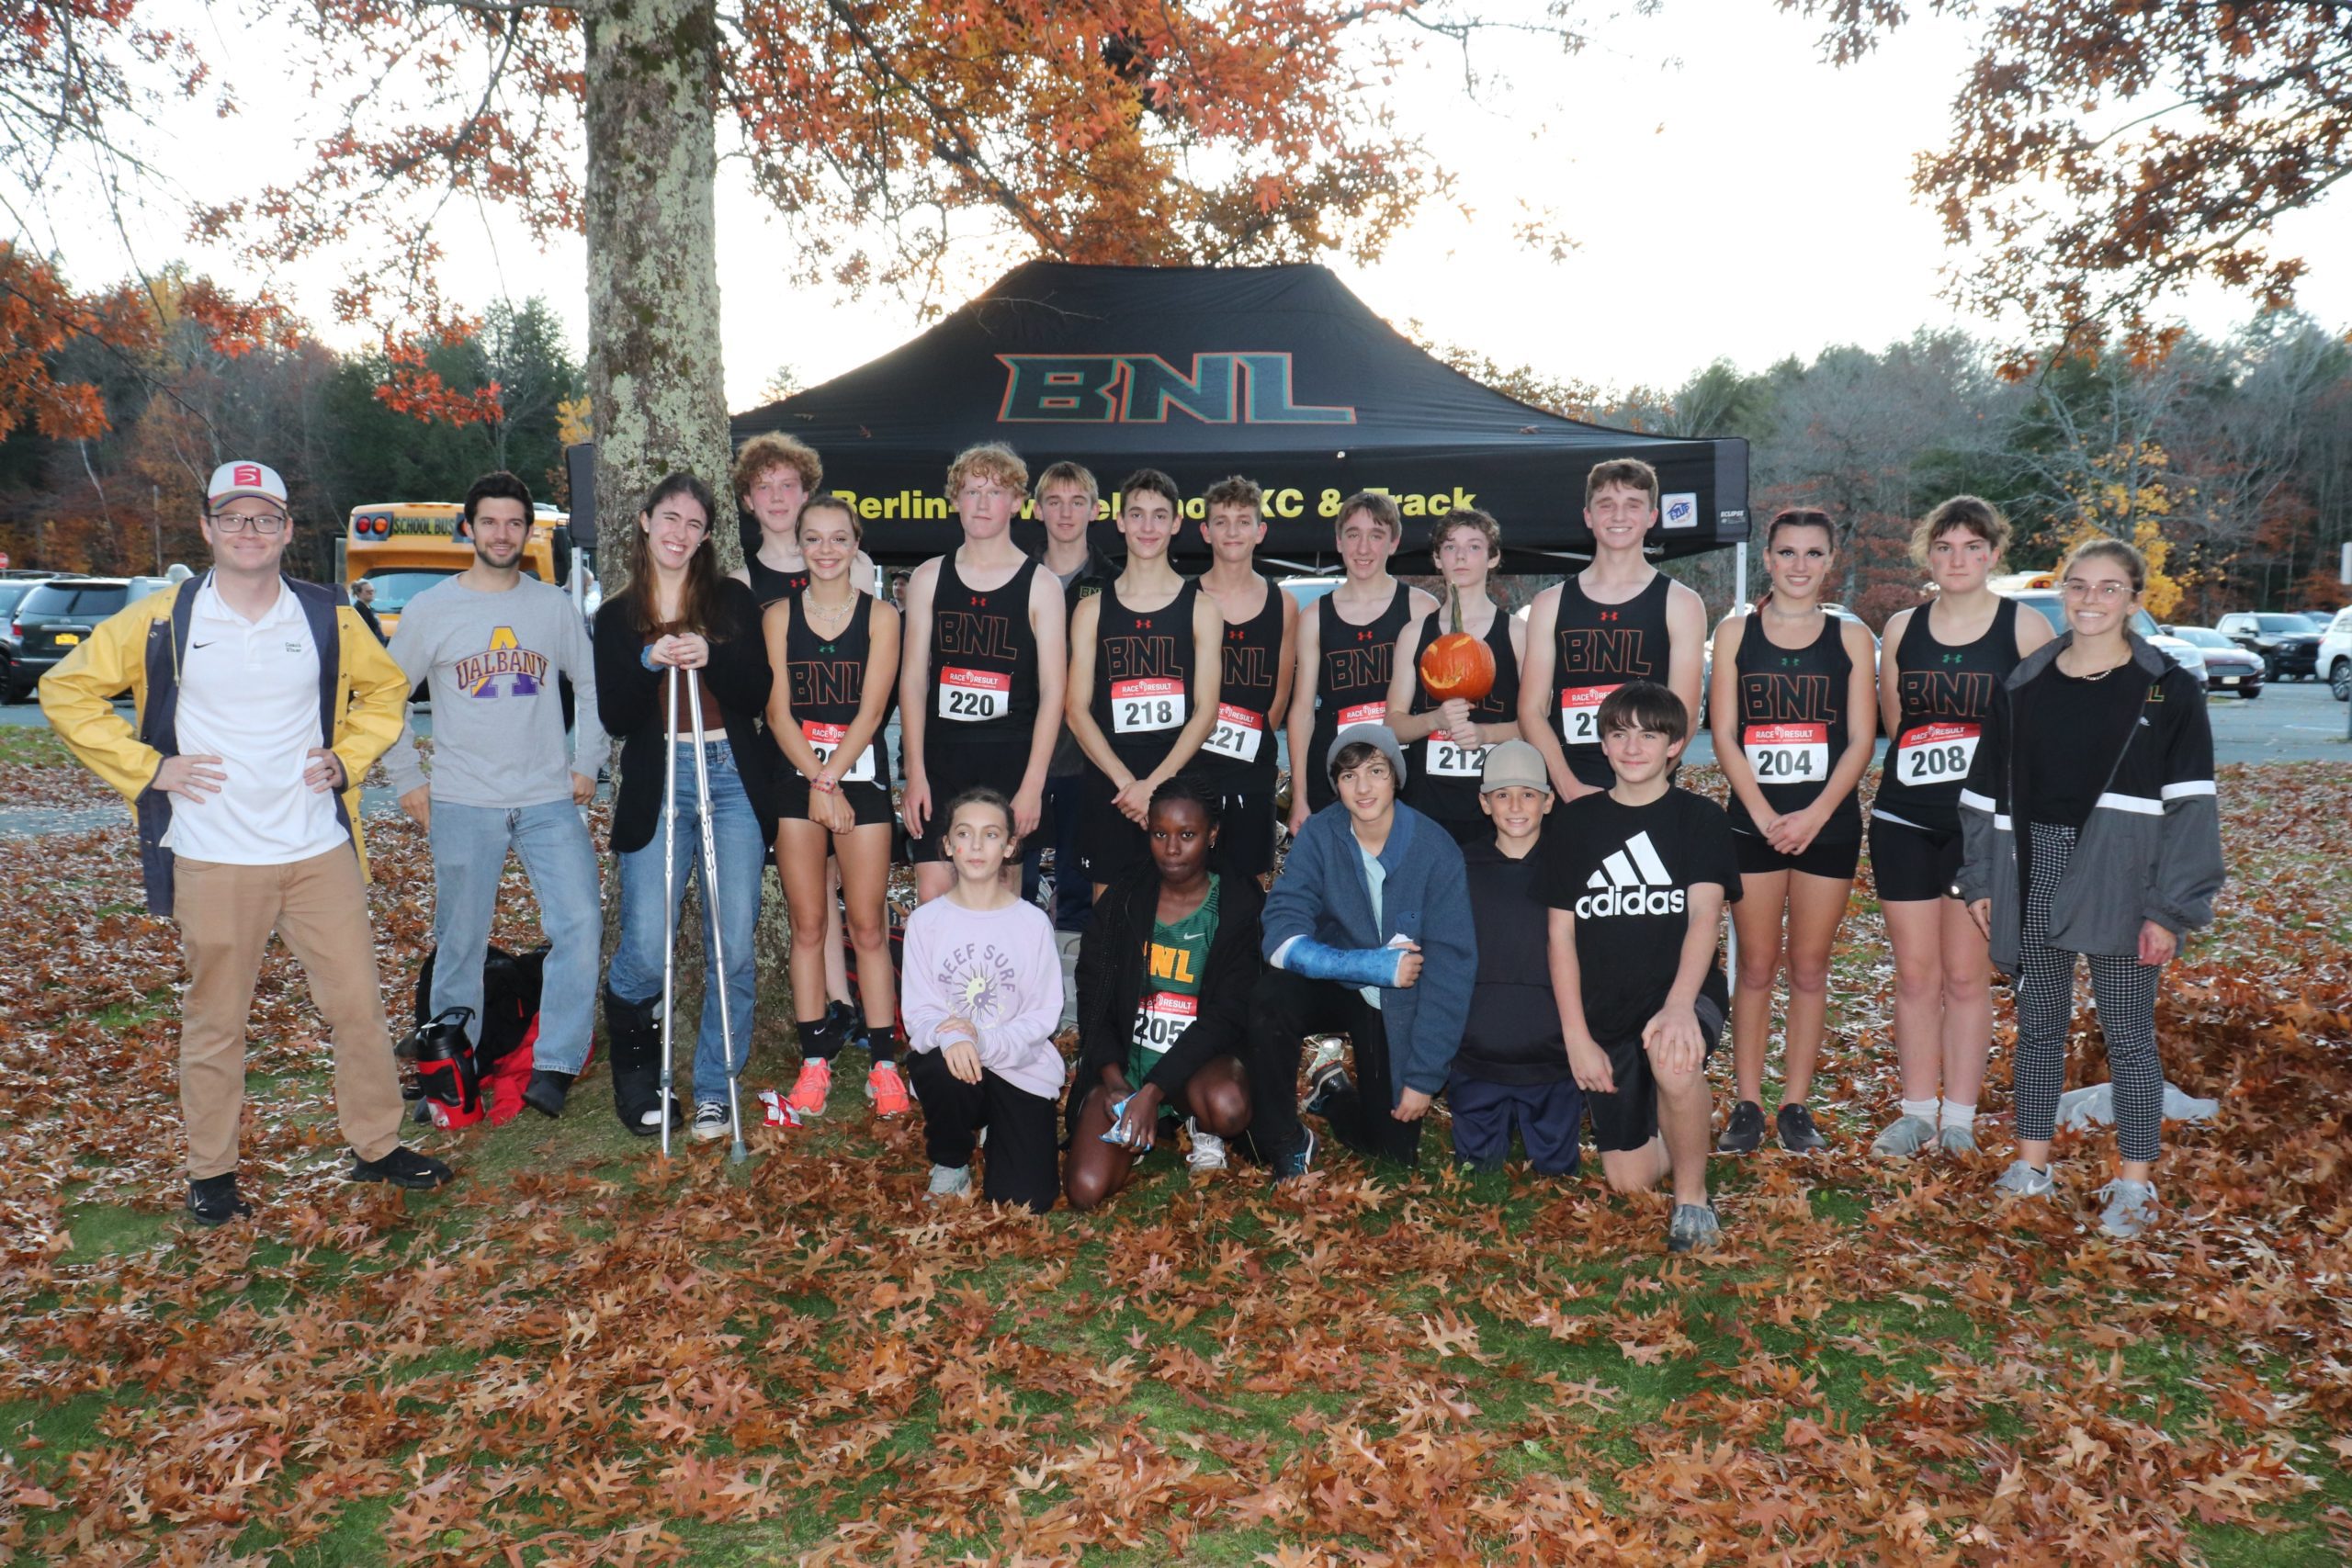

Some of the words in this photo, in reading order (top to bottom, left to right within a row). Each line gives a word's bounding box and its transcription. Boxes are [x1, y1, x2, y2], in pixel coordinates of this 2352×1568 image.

[994, 352, 1357, 424] BNL
[1317, 488, 1344, 518] &
[393, 517, 432, 535] SCHOOL
[435, 517, 455, 535] BUS
[938, 611, 1018, 660] BNL
[1103, 636, 1183, 678] BNL
[1561, 629, 1652, 675] BNL
[456, 650, 548, 691] UALBANY
[949, 673, 967, 682] RACE
[974, 676, 999, 685] RESULT
[1223, 646, 1272, 686] NL
[1122, 684, 1139, 693] RACE
[1147, 682, 1172, 691] RESULT
[1571, 693, 1589, 702] RACE
[1742, 672, 1837, 723] BNL
[949, 690, 995, 716] 220
[1125, 700, 1172, 726] 218
[1347, 709, 1363, 718] RACE
[1232, 710, 1255, 723] RESULT
[812, 728, 829, 738] RACE
[1756, 730, 1775, 739] RACE
[1784, 729, 1814, 739] RESULT
[1911, 732, 1928, 741] RACE
[1936, 727, 1966, 736] RESULT
[1439, 746, 1487, 770] 212
[1758, 750, 1813, 776] 204
[1911, 745, 1967, 778] 208
[1575, 884, 1685, 919] adidas
[937, 942, 975, 985] REEF
[983, 943, 1016, 993] SURF
[1143, 941, 1194, 984] NL
[1162, 998, 1193, 1010] RESULT
[1134, 1013, 1186, 1046] 205
